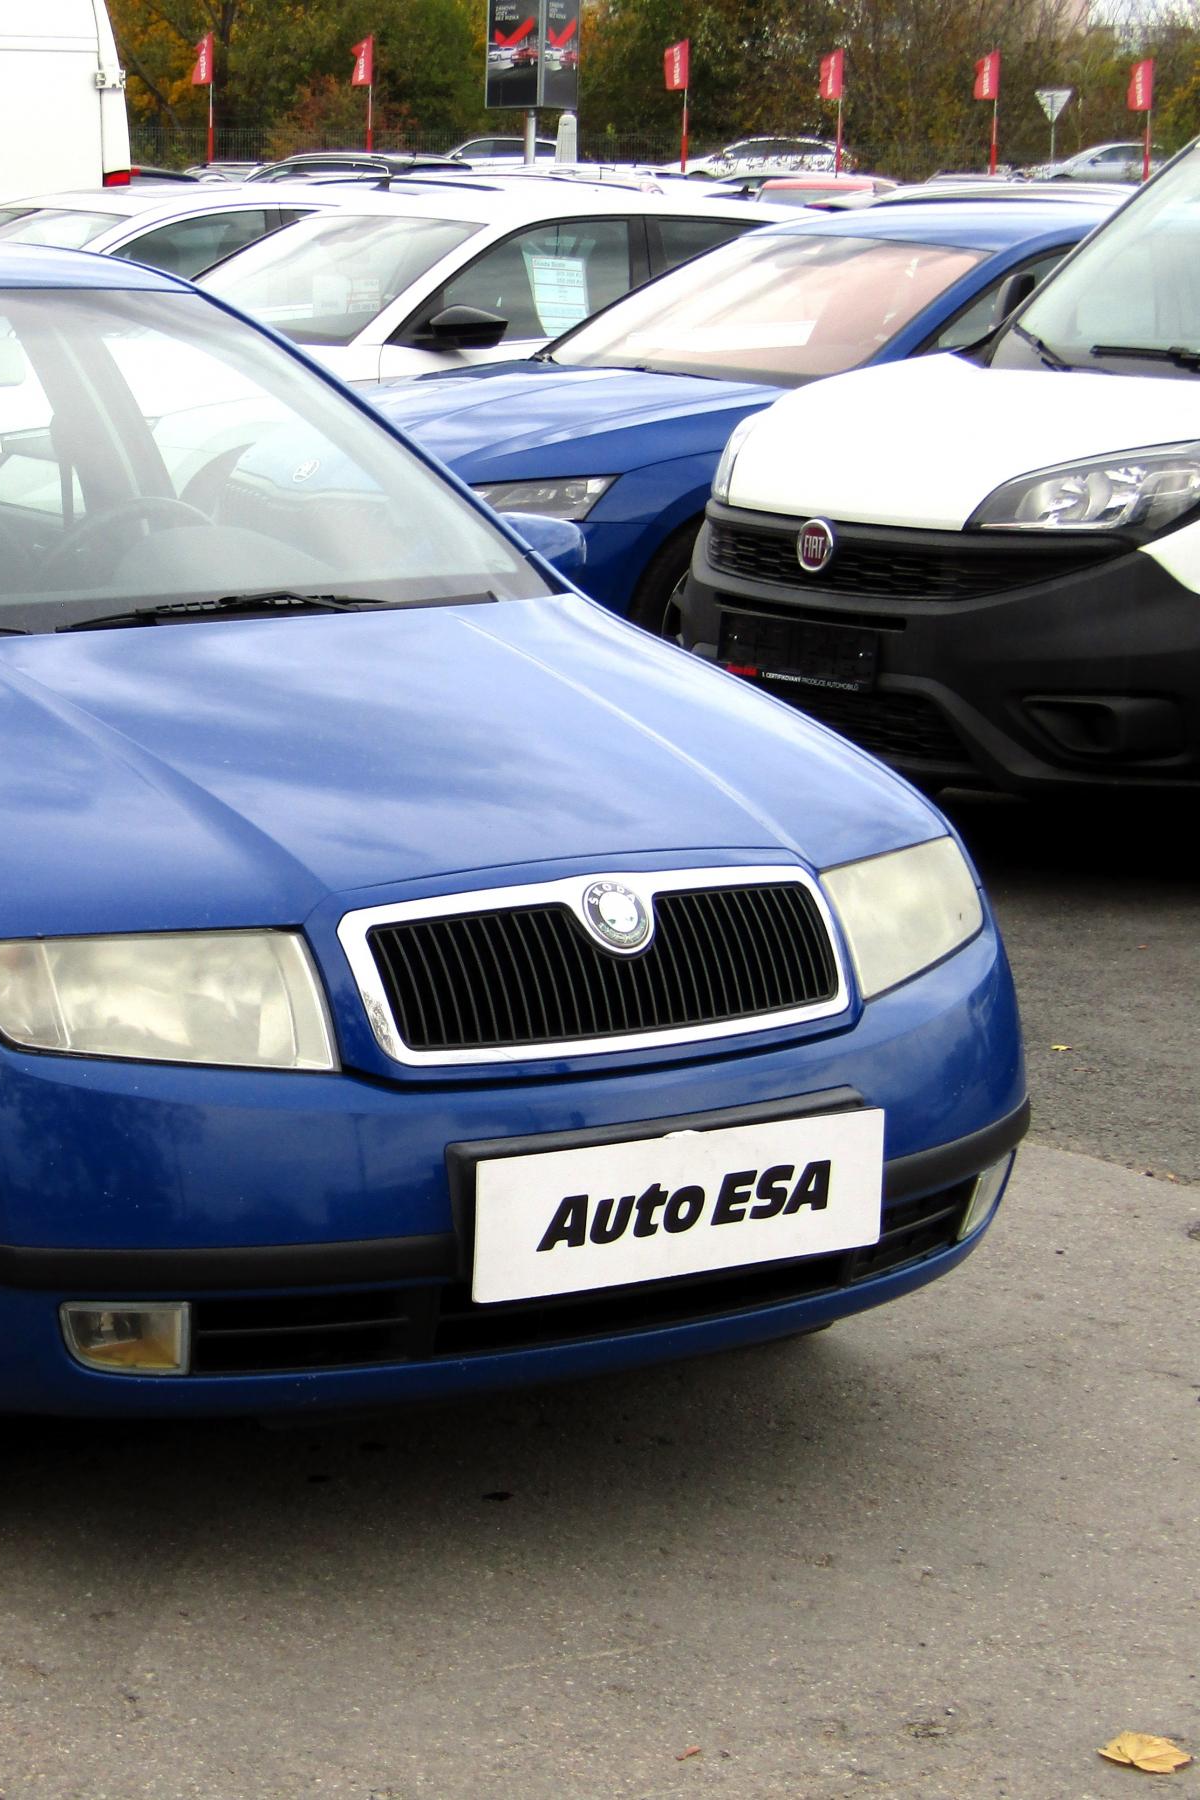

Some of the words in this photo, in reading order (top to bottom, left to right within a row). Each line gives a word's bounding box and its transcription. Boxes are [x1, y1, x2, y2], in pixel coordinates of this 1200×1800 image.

[803, 534, 825, 559] FIAT
[536, 1182, 705, 1253] Auto
[710, 1159, 832, 1226] ESA
